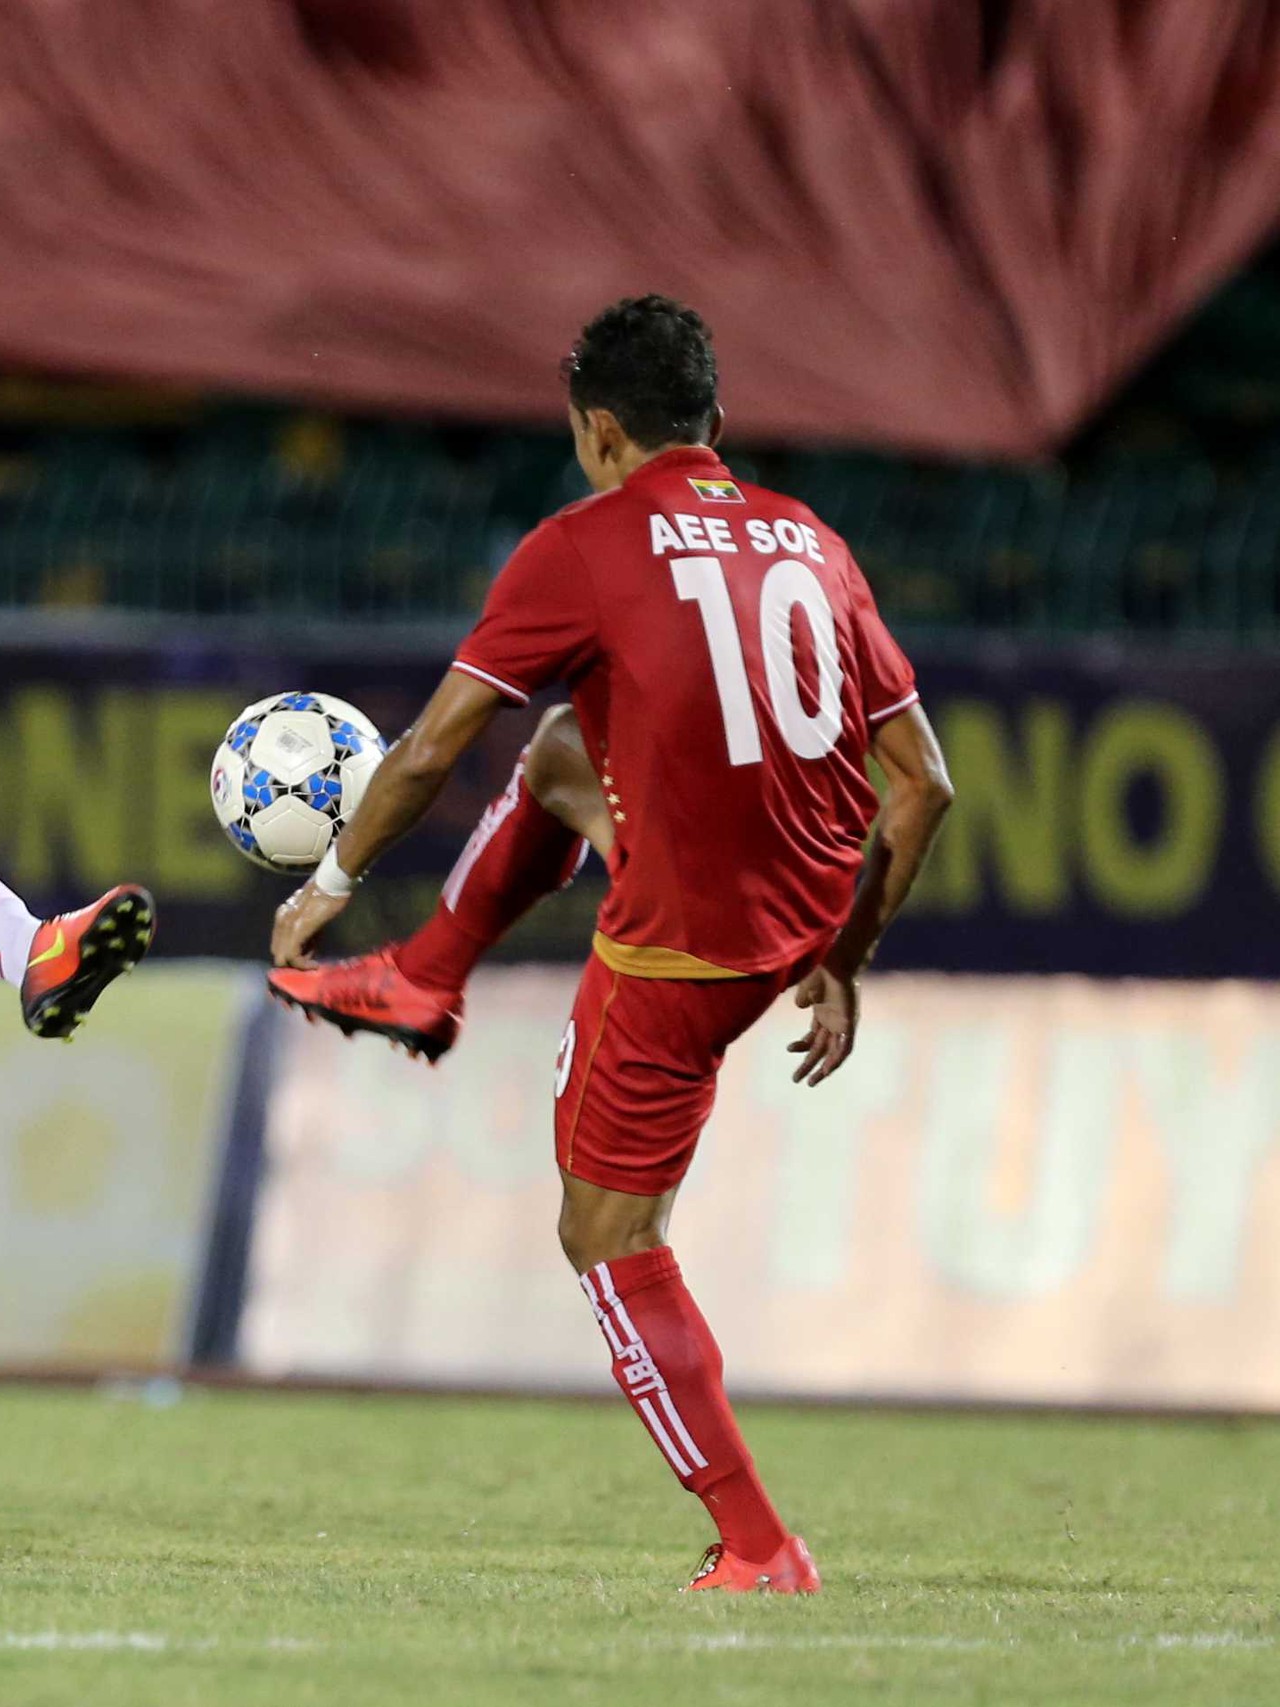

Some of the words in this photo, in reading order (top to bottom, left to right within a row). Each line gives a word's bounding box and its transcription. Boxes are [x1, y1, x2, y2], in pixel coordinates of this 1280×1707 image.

[650, 513, 738, 555] AEE
[750, 518, 825, 563] SOE
[670, 556, 845, 767] 10
[617, 1341, 668, 1397] FBT
